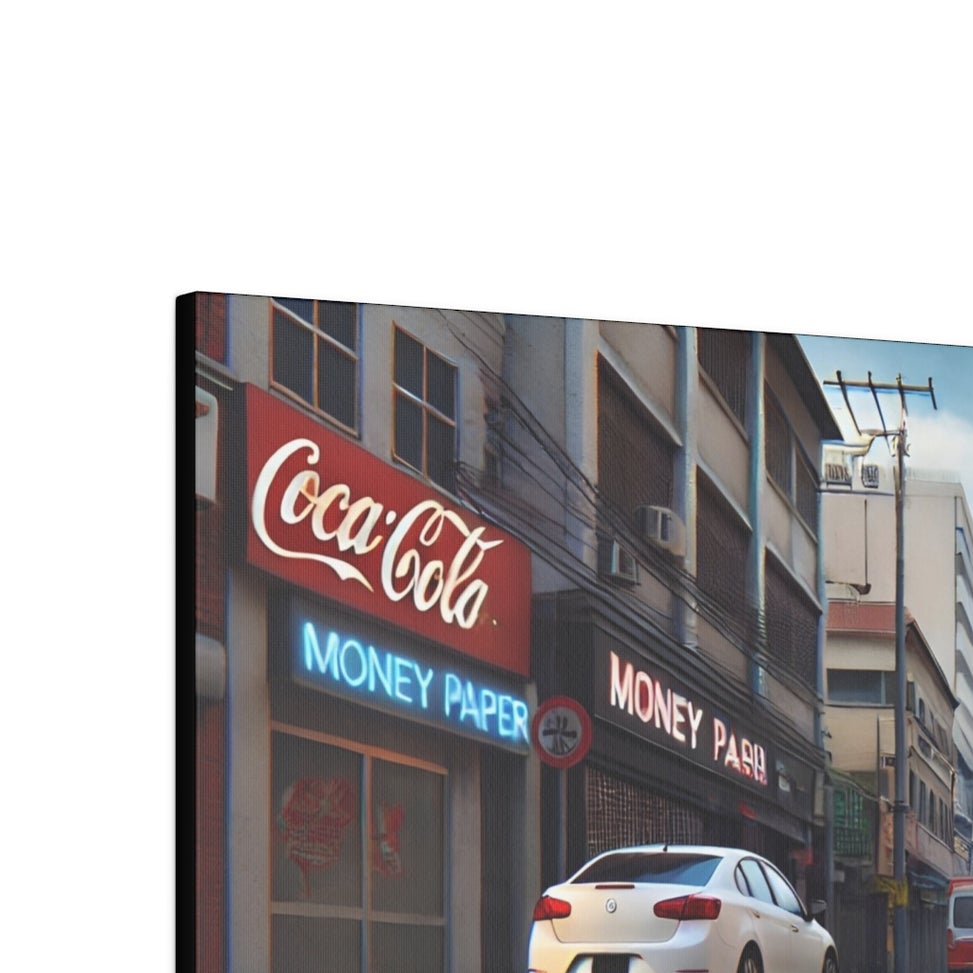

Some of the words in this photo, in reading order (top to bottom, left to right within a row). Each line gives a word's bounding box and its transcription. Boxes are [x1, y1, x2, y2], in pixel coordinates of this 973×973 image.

[303, 622, 434, 709] MONEY
[444, 674, 529, 744] PAPER
[610, 651, 703, 749] MONEY
